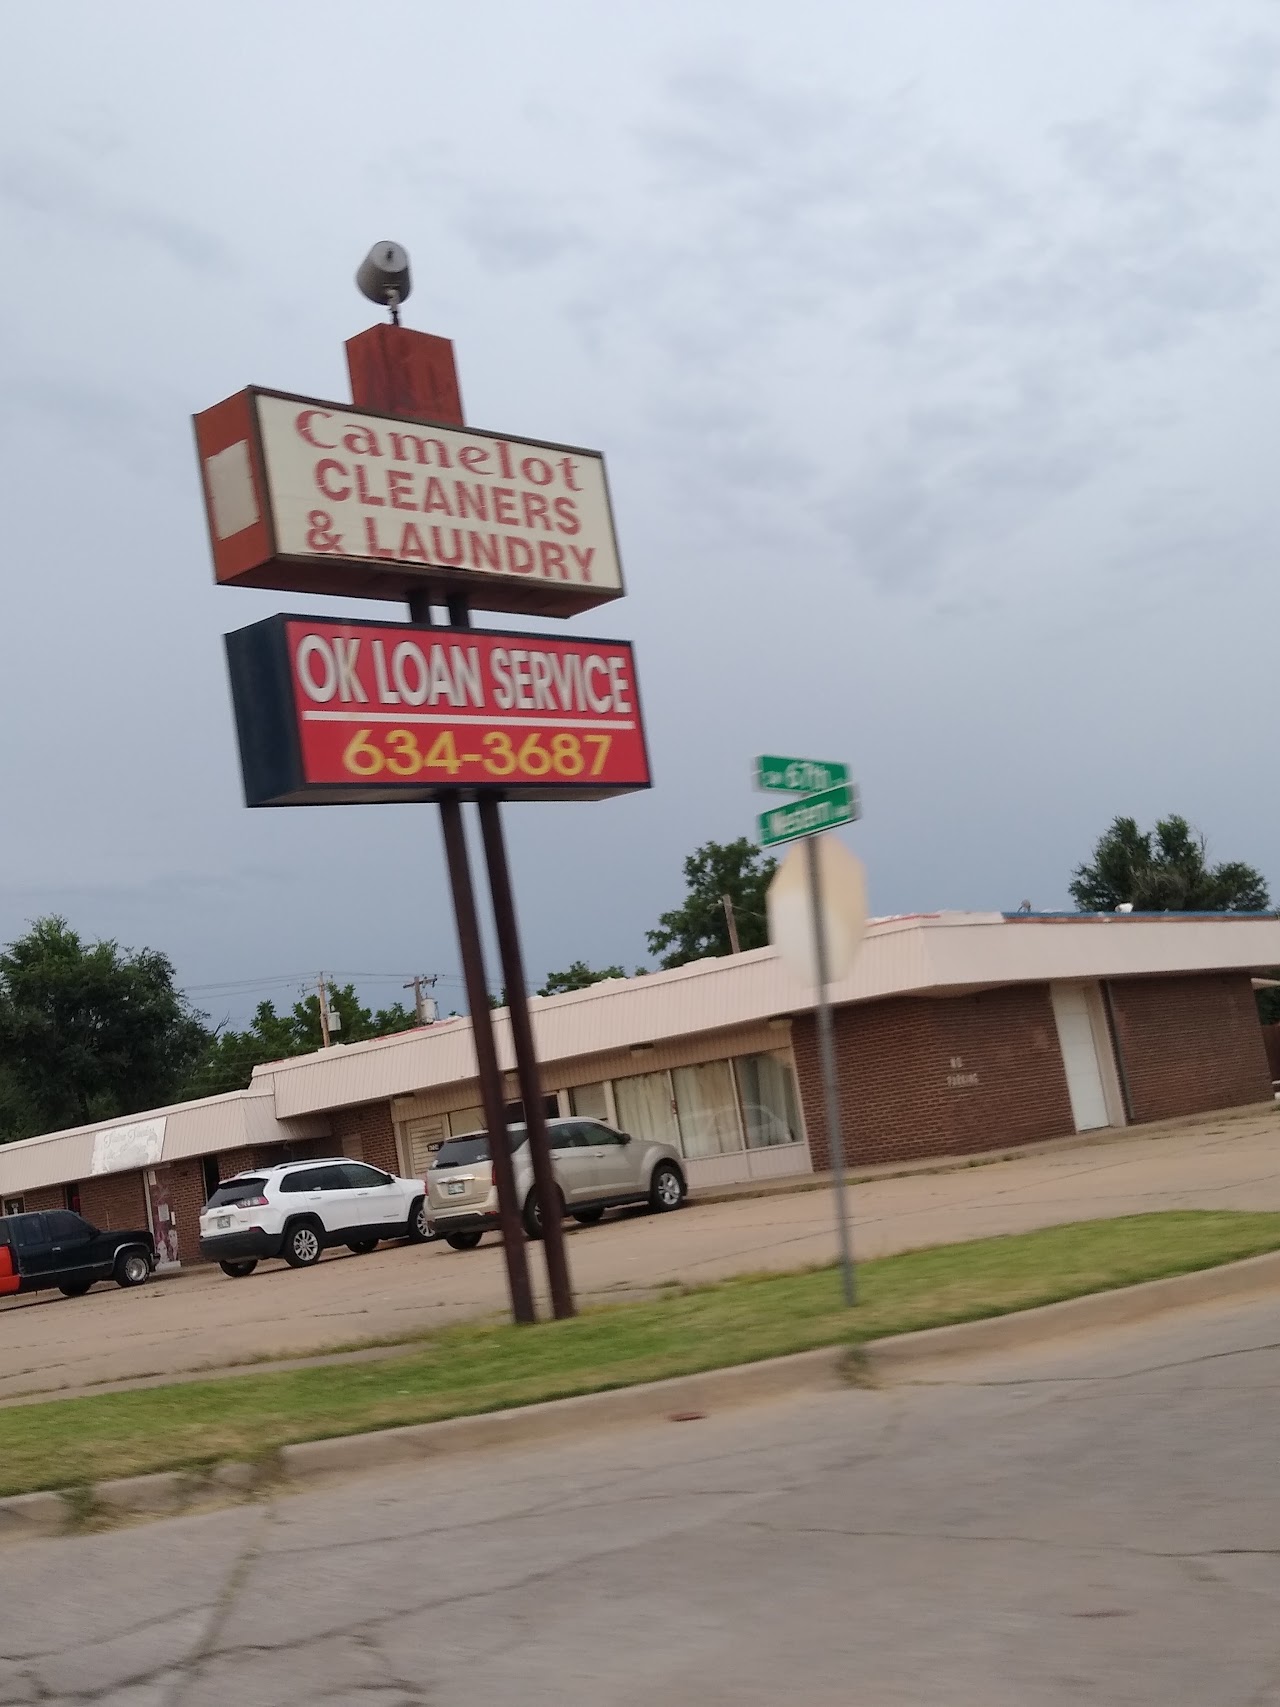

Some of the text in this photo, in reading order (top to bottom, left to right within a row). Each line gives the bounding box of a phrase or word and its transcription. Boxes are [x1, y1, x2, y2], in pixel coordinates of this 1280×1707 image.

[295, 409, 584, 492] Camelot
[314, 457, 582, 536] CLEANERS
[305, 508, 596, 583] & LAUNDRY
[298, 634, 633, 715] OK LOAN SERVICE
[342, 728, 613, 777] 634-3687
